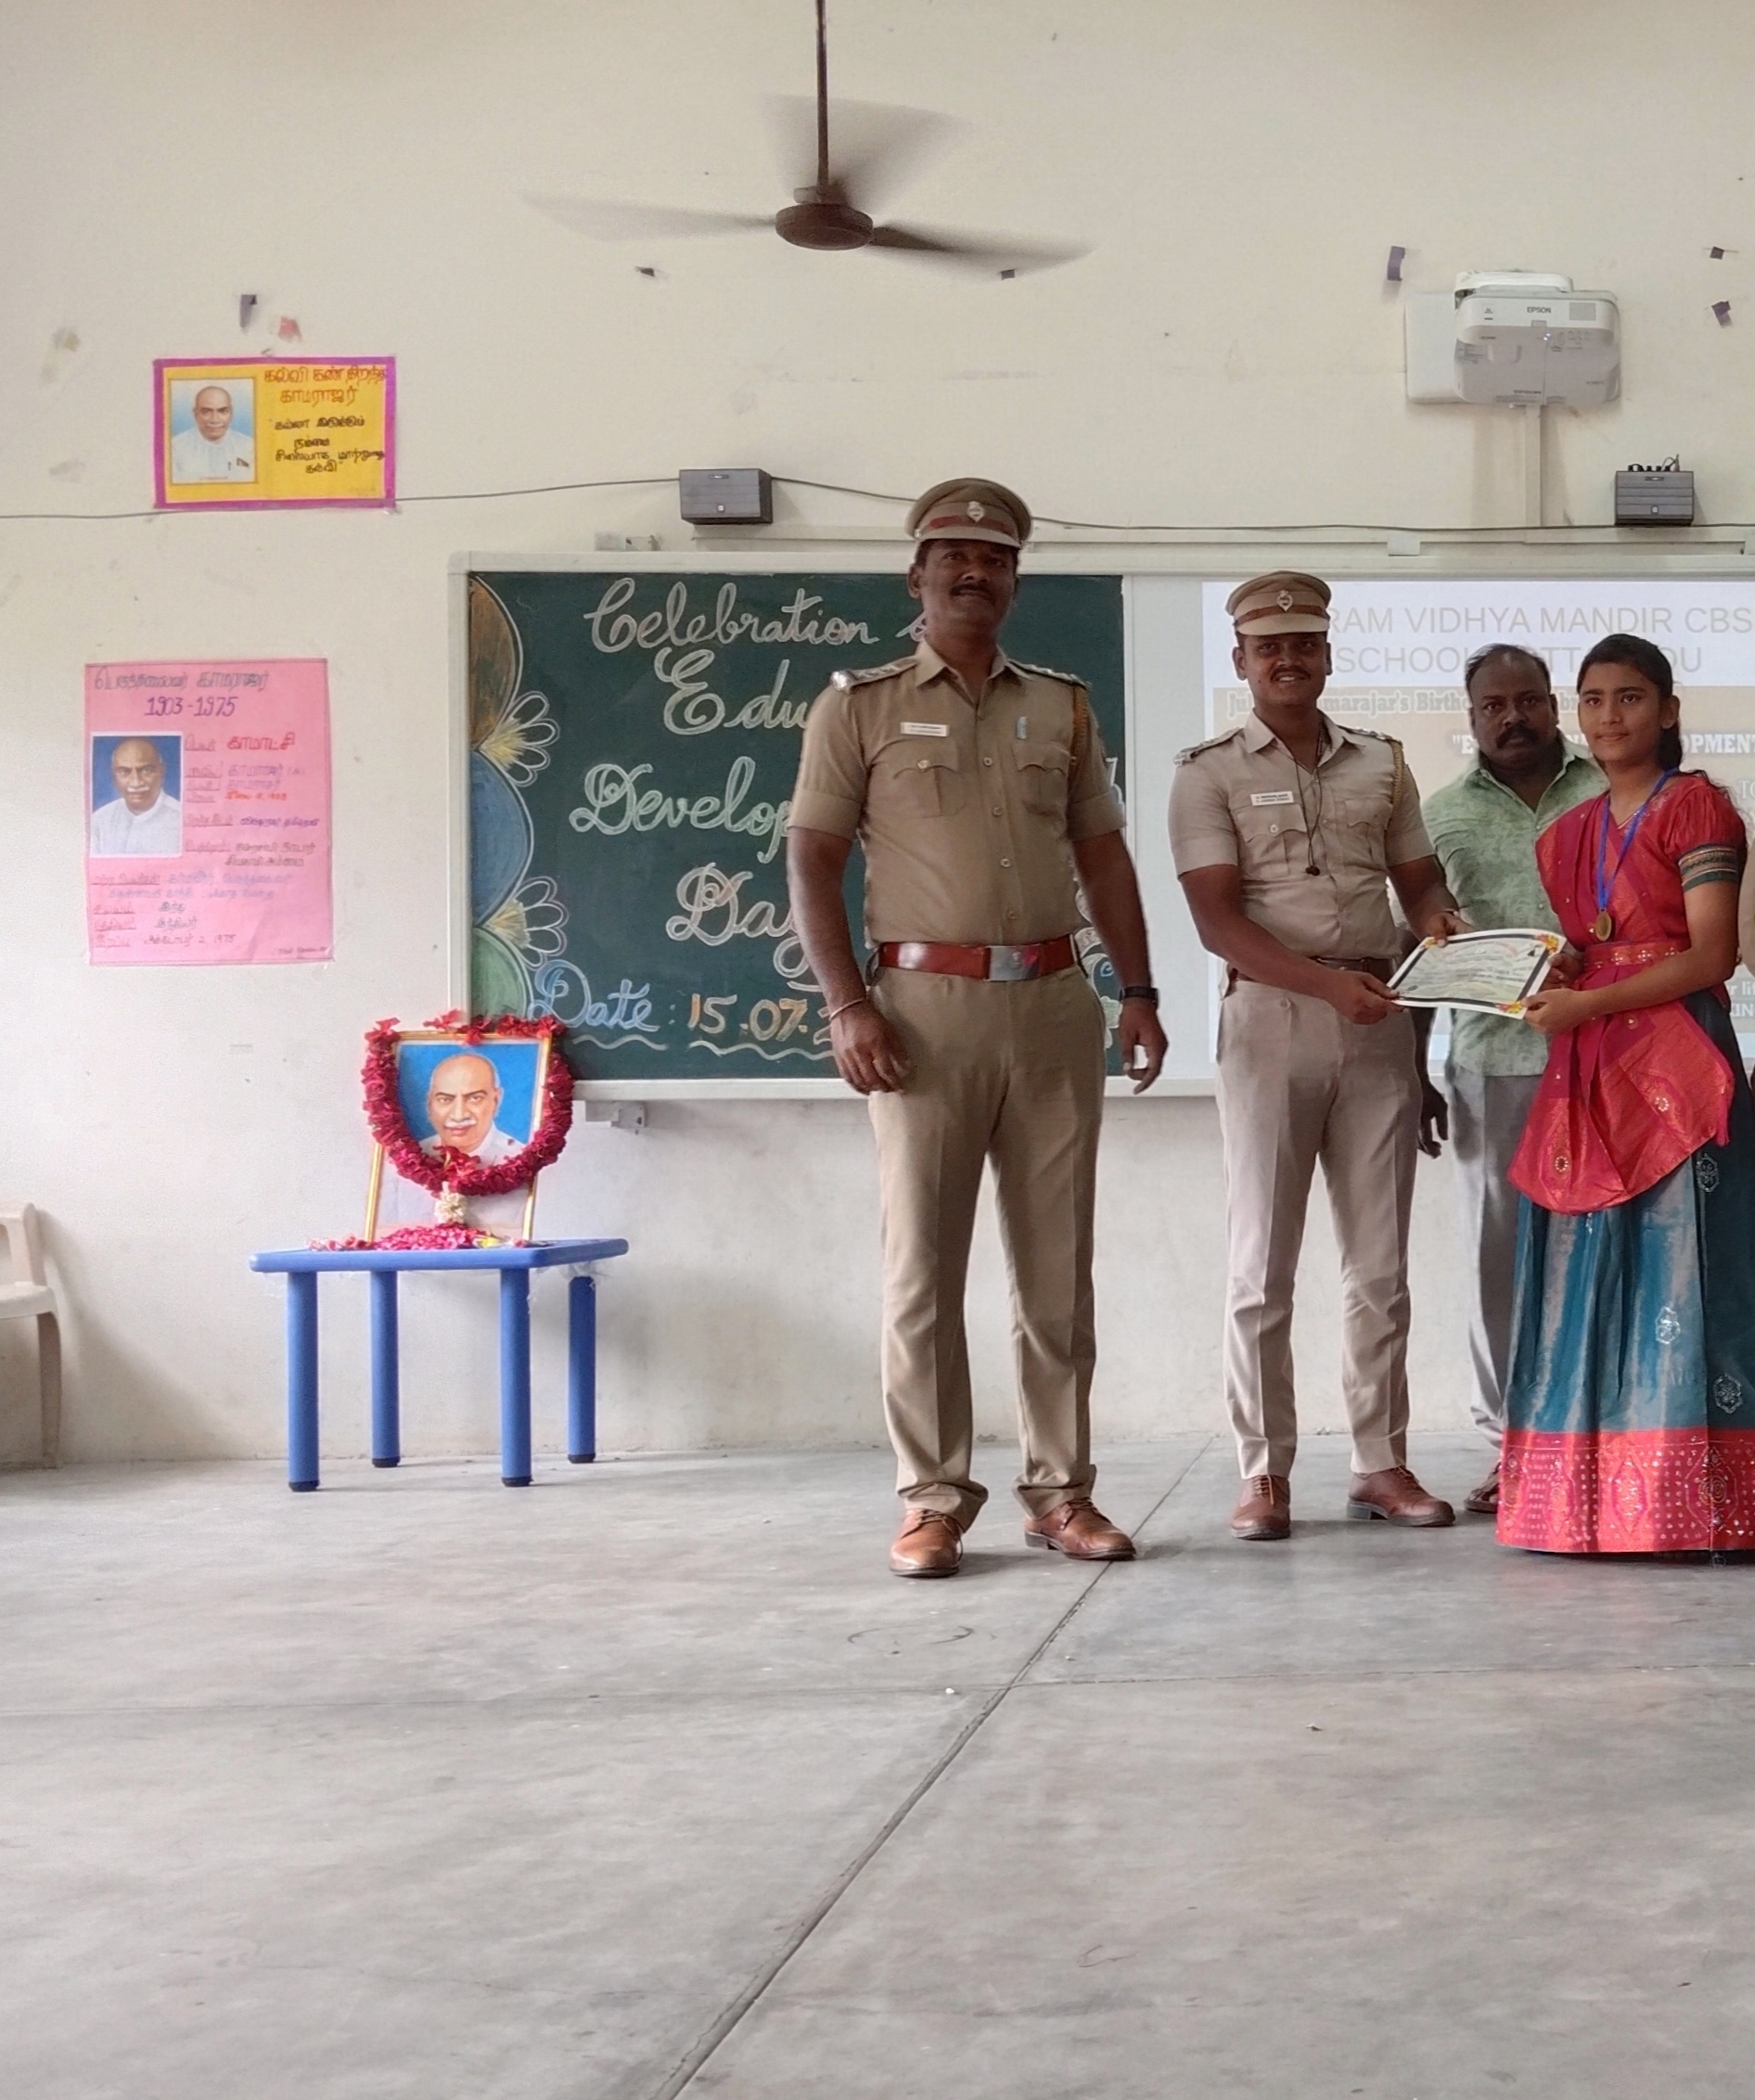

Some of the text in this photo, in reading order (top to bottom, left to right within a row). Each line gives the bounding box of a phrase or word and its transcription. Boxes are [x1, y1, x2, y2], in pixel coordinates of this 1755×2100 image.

[583, 577, 881, 653] Celebration
[1404, 608, 1531, 633] VIDHYA
[1540, 608, 1673, 633] MANDIR
[653, 647, 809, 736] Edu
[569, 756, 796, 864] Develop
